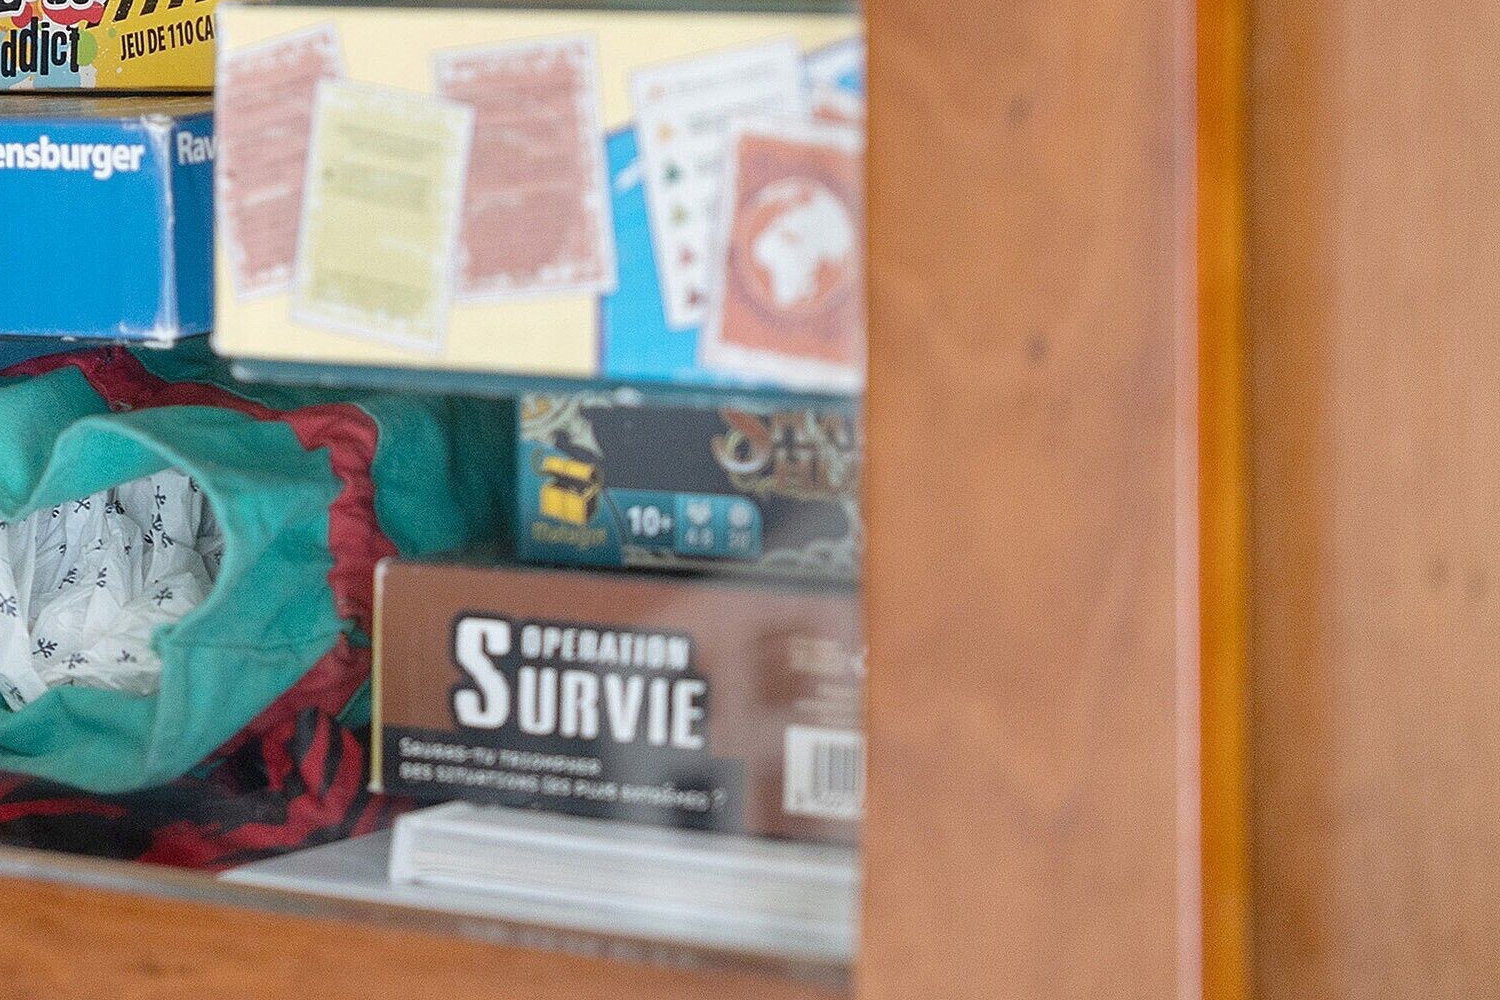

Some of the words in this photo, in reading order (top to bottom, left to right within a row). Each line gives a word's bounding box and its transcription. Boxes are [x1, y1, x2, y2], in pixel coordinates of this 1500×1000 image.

[120, 31, 146, 61] JEU
[148, 26, 166, 55] DE
[169, 20, 194, 51] 110
[626, 504, 673, 538] 10+
[520, 624, 690, 672] OPERATION
[452, 615, 708, 750] SURVIE
